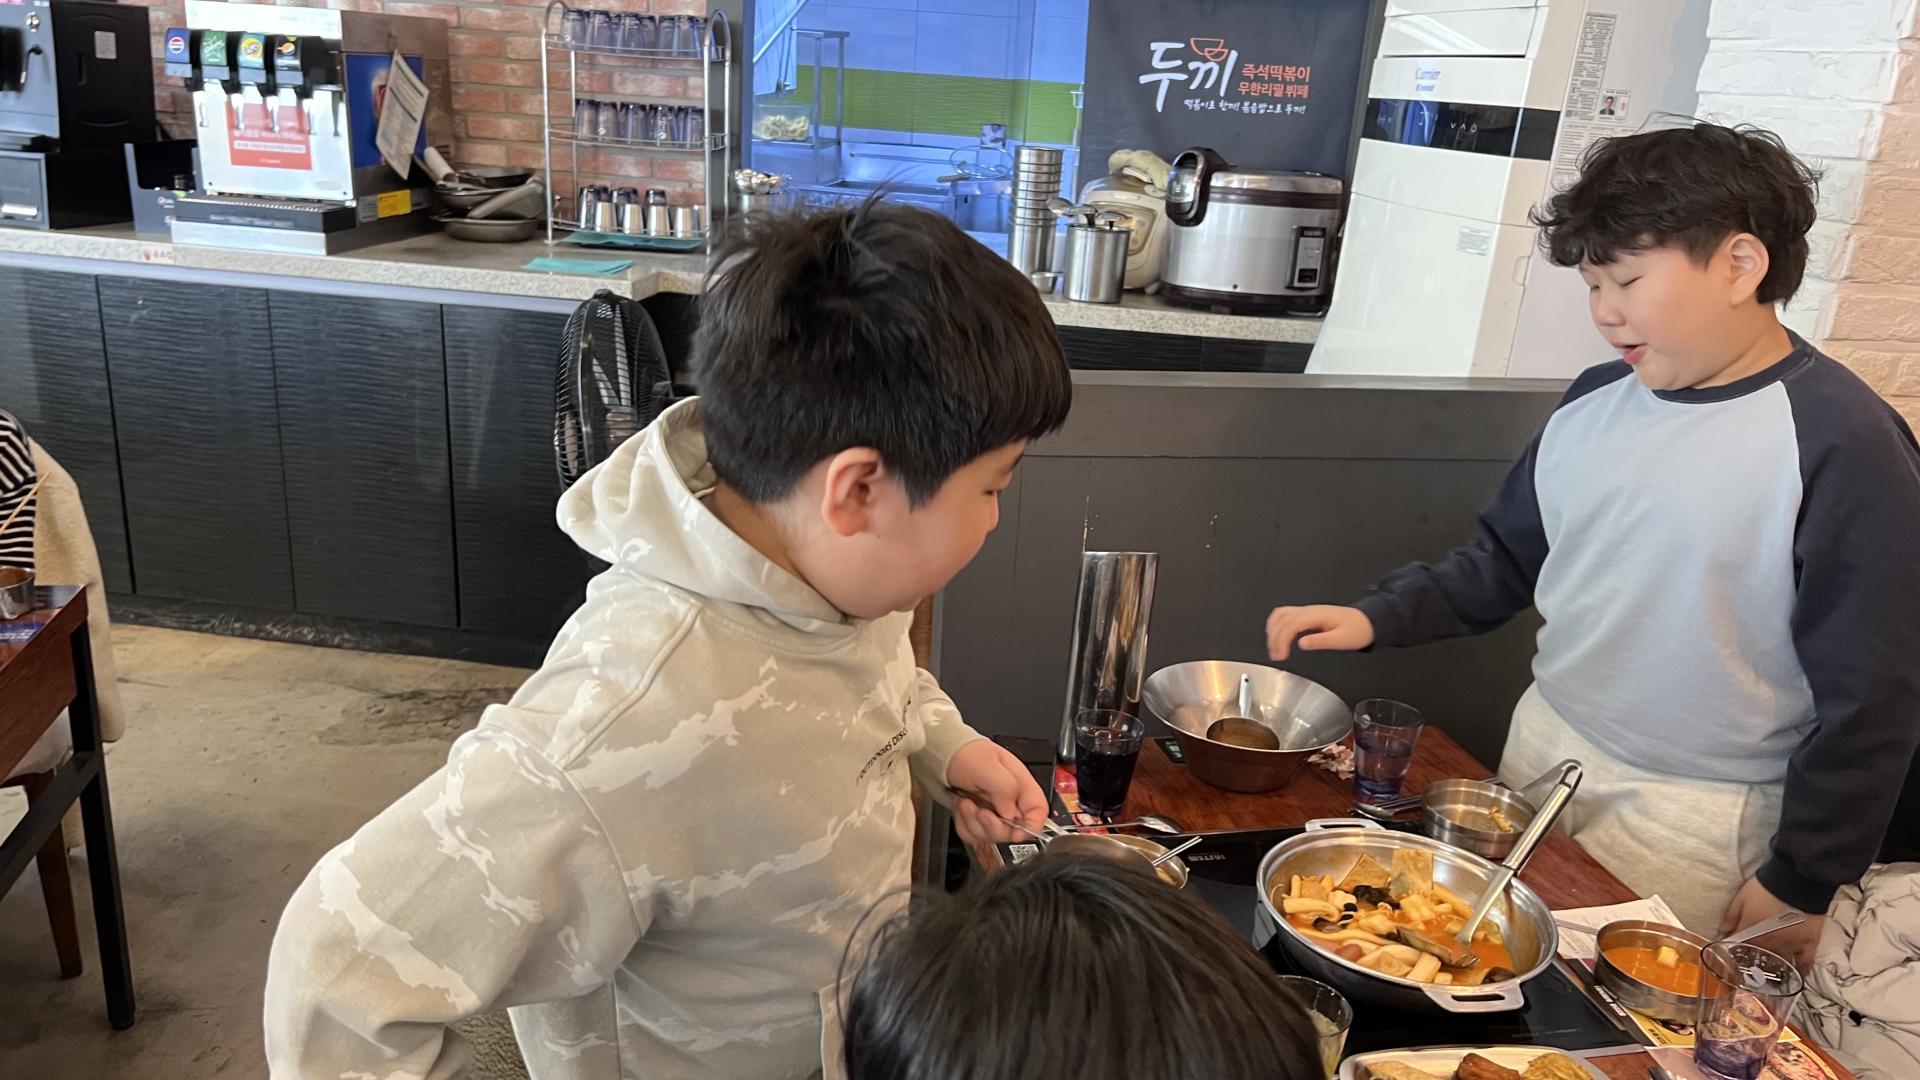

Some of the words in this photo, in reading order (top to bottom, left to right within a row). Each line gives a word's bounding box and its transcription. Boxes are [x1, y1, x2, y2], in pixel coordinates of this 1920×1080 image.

[1139, 42, 1239, 113] 두끼
[1241, 63, 1311, 83] 즉석떡볶이
[1238, 83, 1284, 97] 무한리필
[1285, 85, 1309, 99] 뷔페
